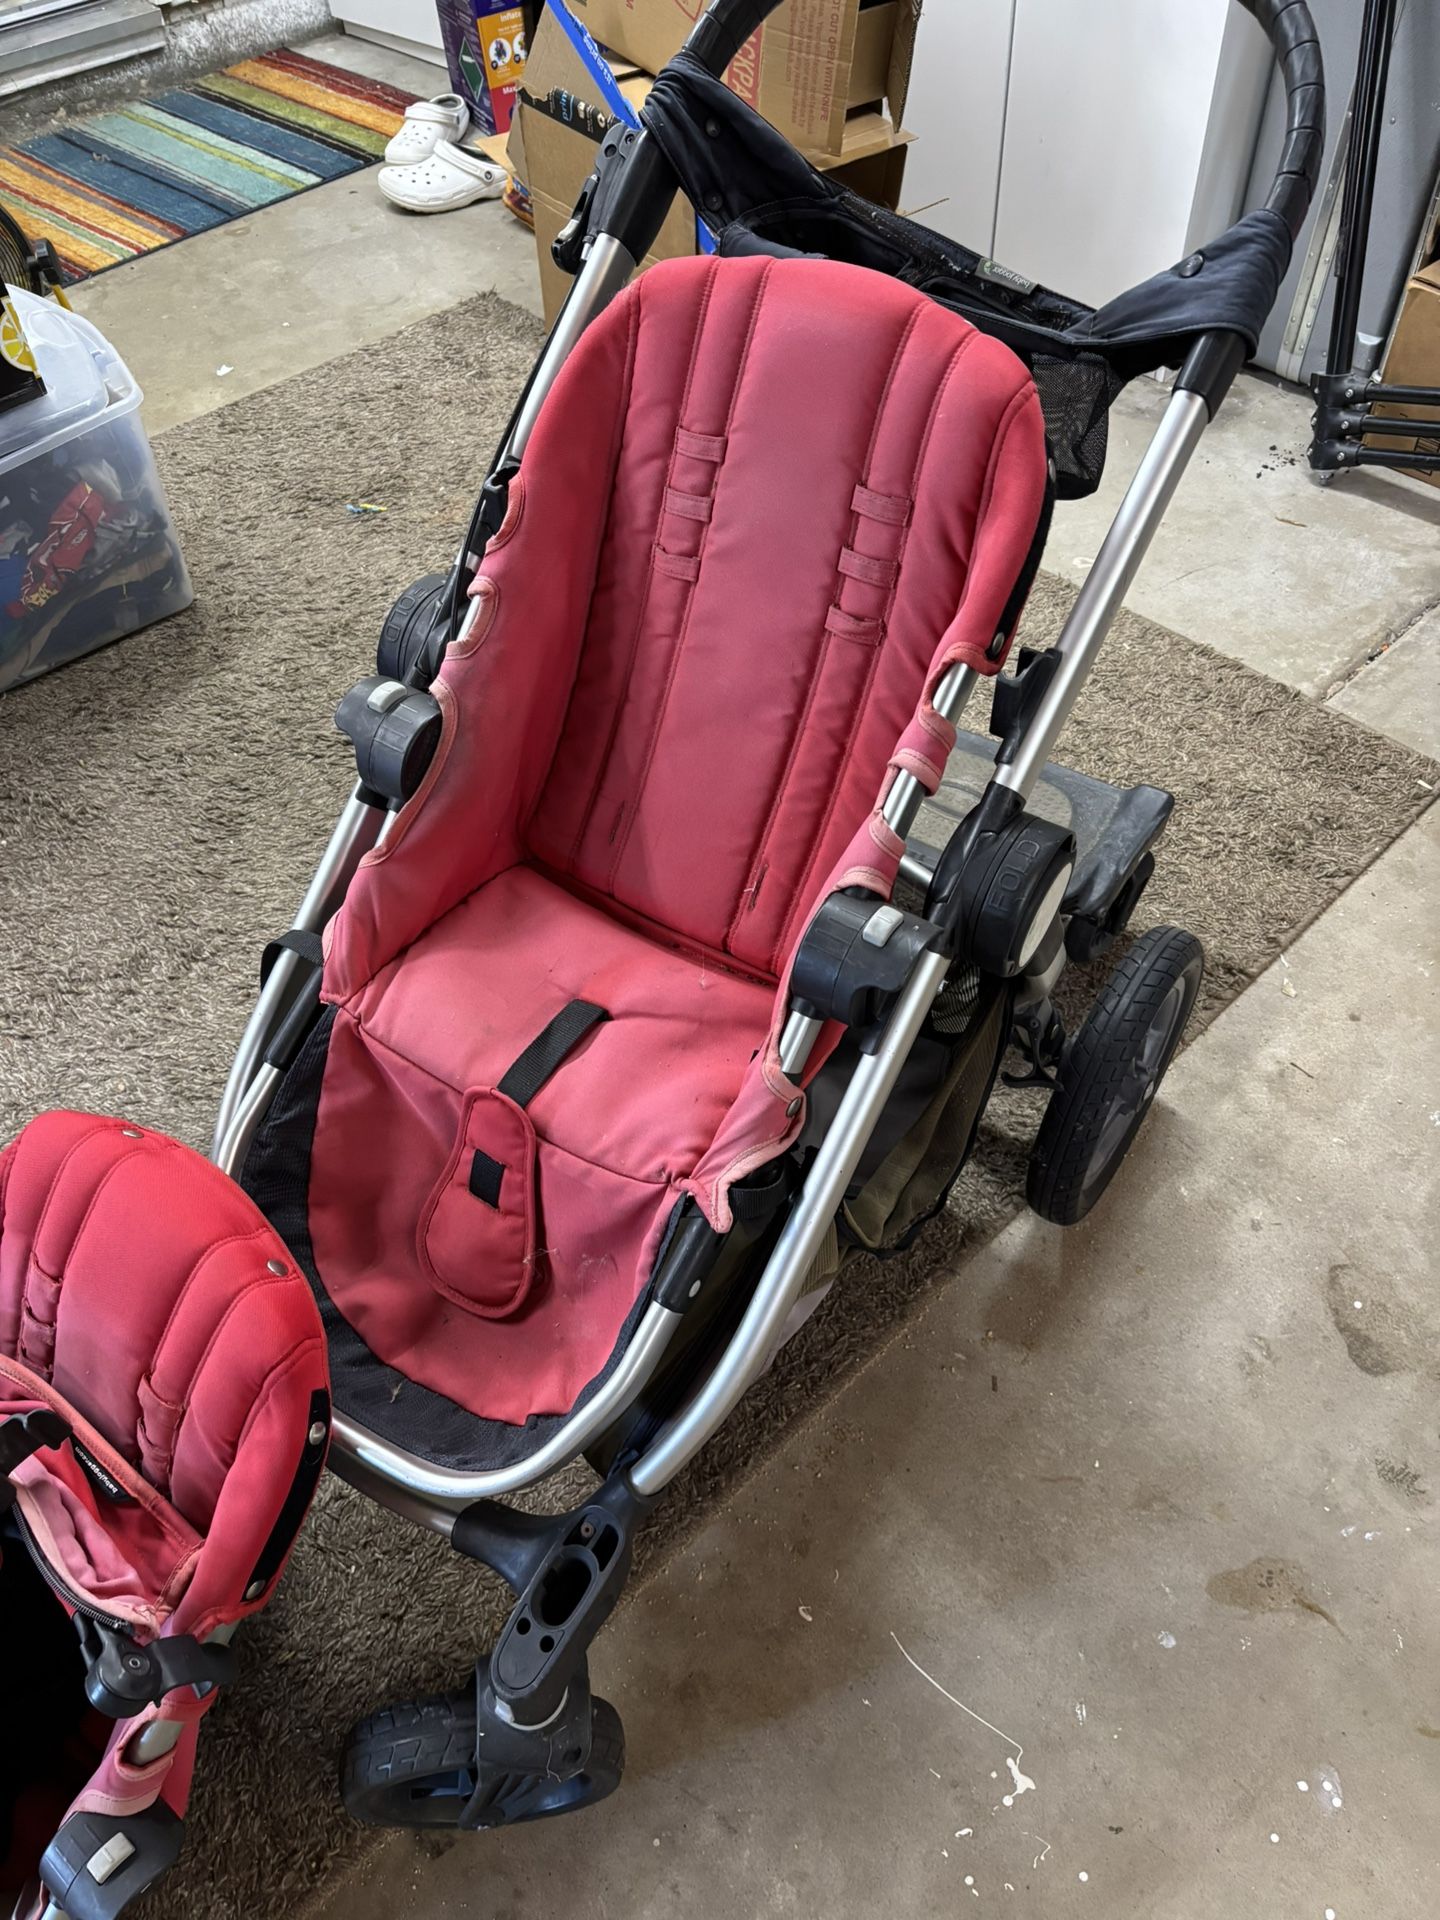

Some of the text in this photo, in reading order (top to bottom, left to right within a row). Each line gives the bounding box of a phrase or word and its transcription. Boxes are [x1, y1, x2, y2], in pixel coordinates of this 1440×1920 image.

[830, 15, 839, 33] CUT
[820, 93, 831, 122] KNIFE
[988, 839, 1041, 913] FOLD
[75, 1446, 118, 1493] babyjogger.com
